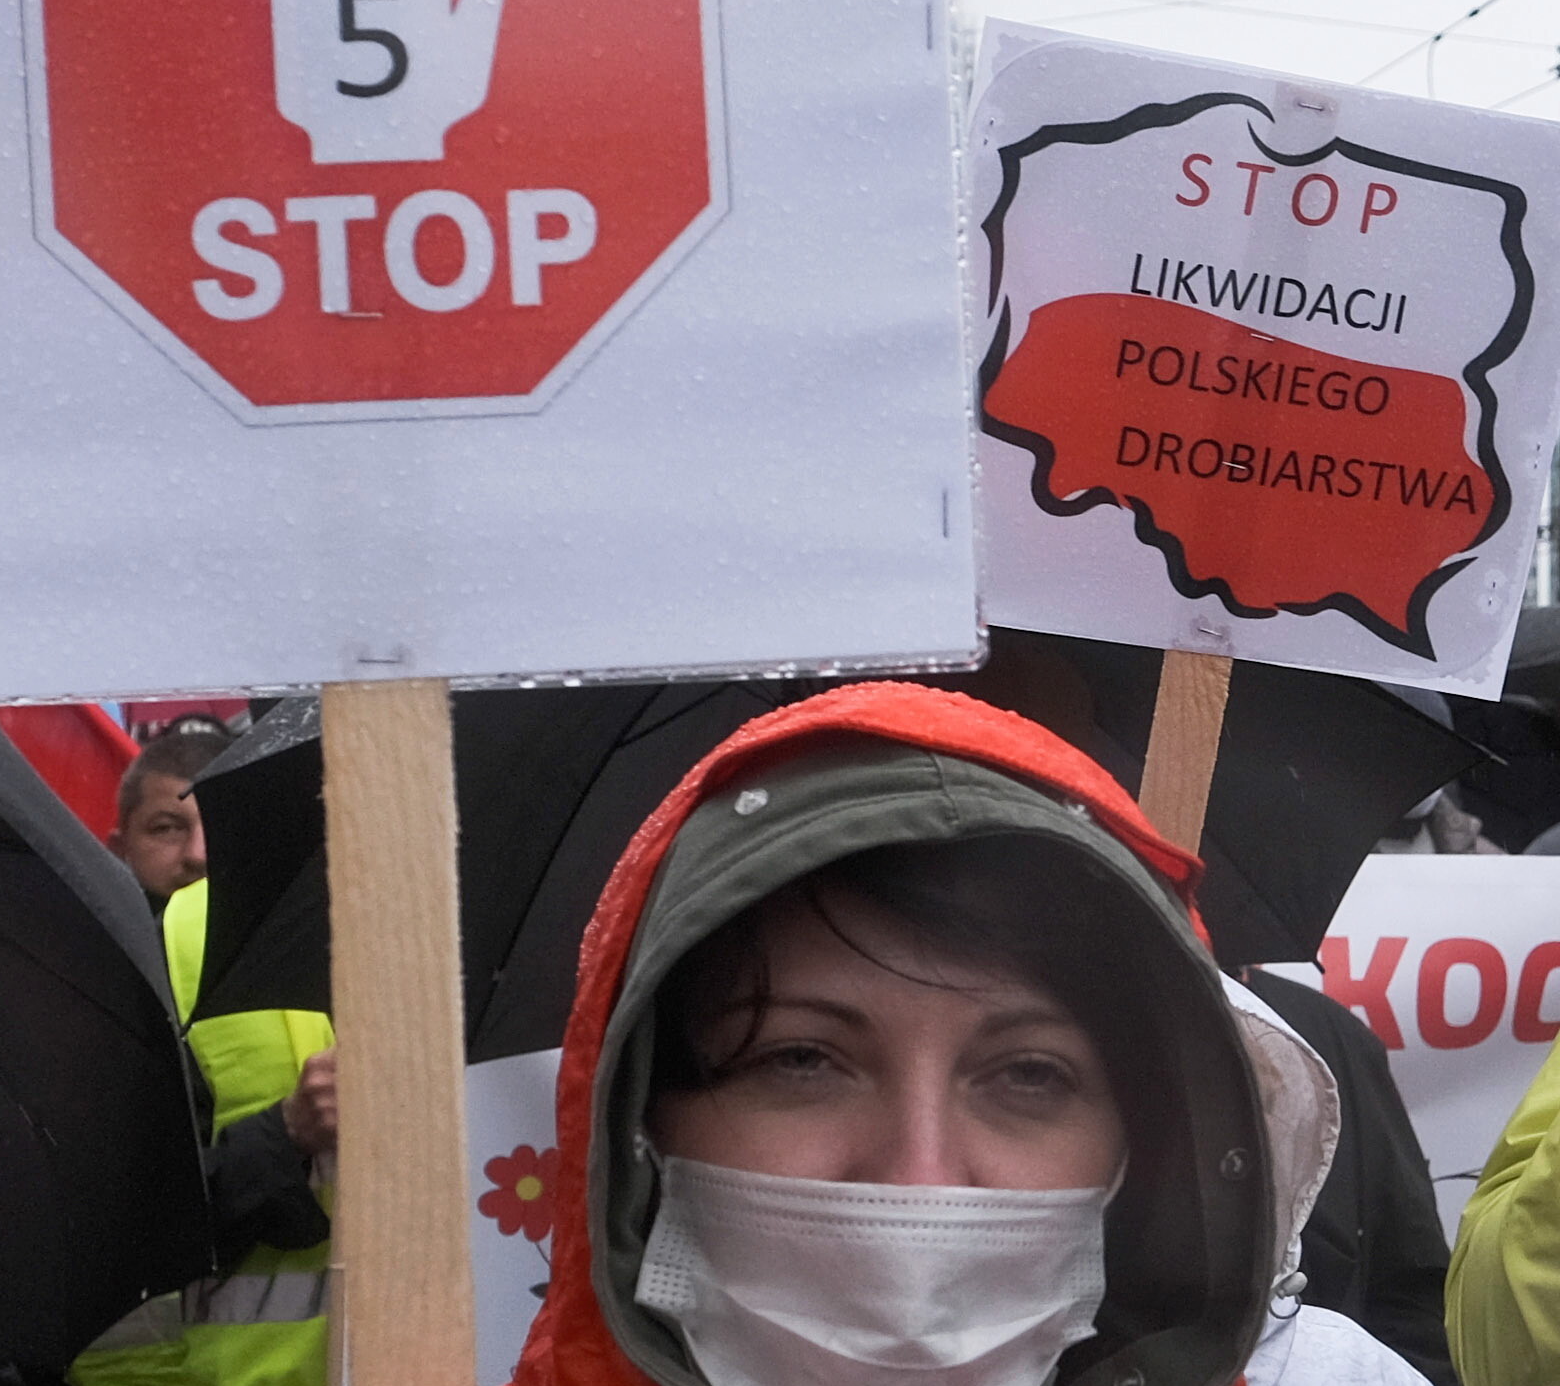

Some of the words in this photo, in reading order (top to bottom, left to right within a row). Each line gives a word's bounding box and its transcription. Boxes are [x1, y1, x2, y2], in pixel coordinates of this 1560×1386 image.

[1176, 153, 1398, 234] STOP
[191, 188, 598, 321] STOP
[1129, 253, 1407, 334] LIKWIDACJI
[1116, 339, 1390, 415] POLSKIEGO
[1117, 426, 1476, 515] DROBIARSTWA
